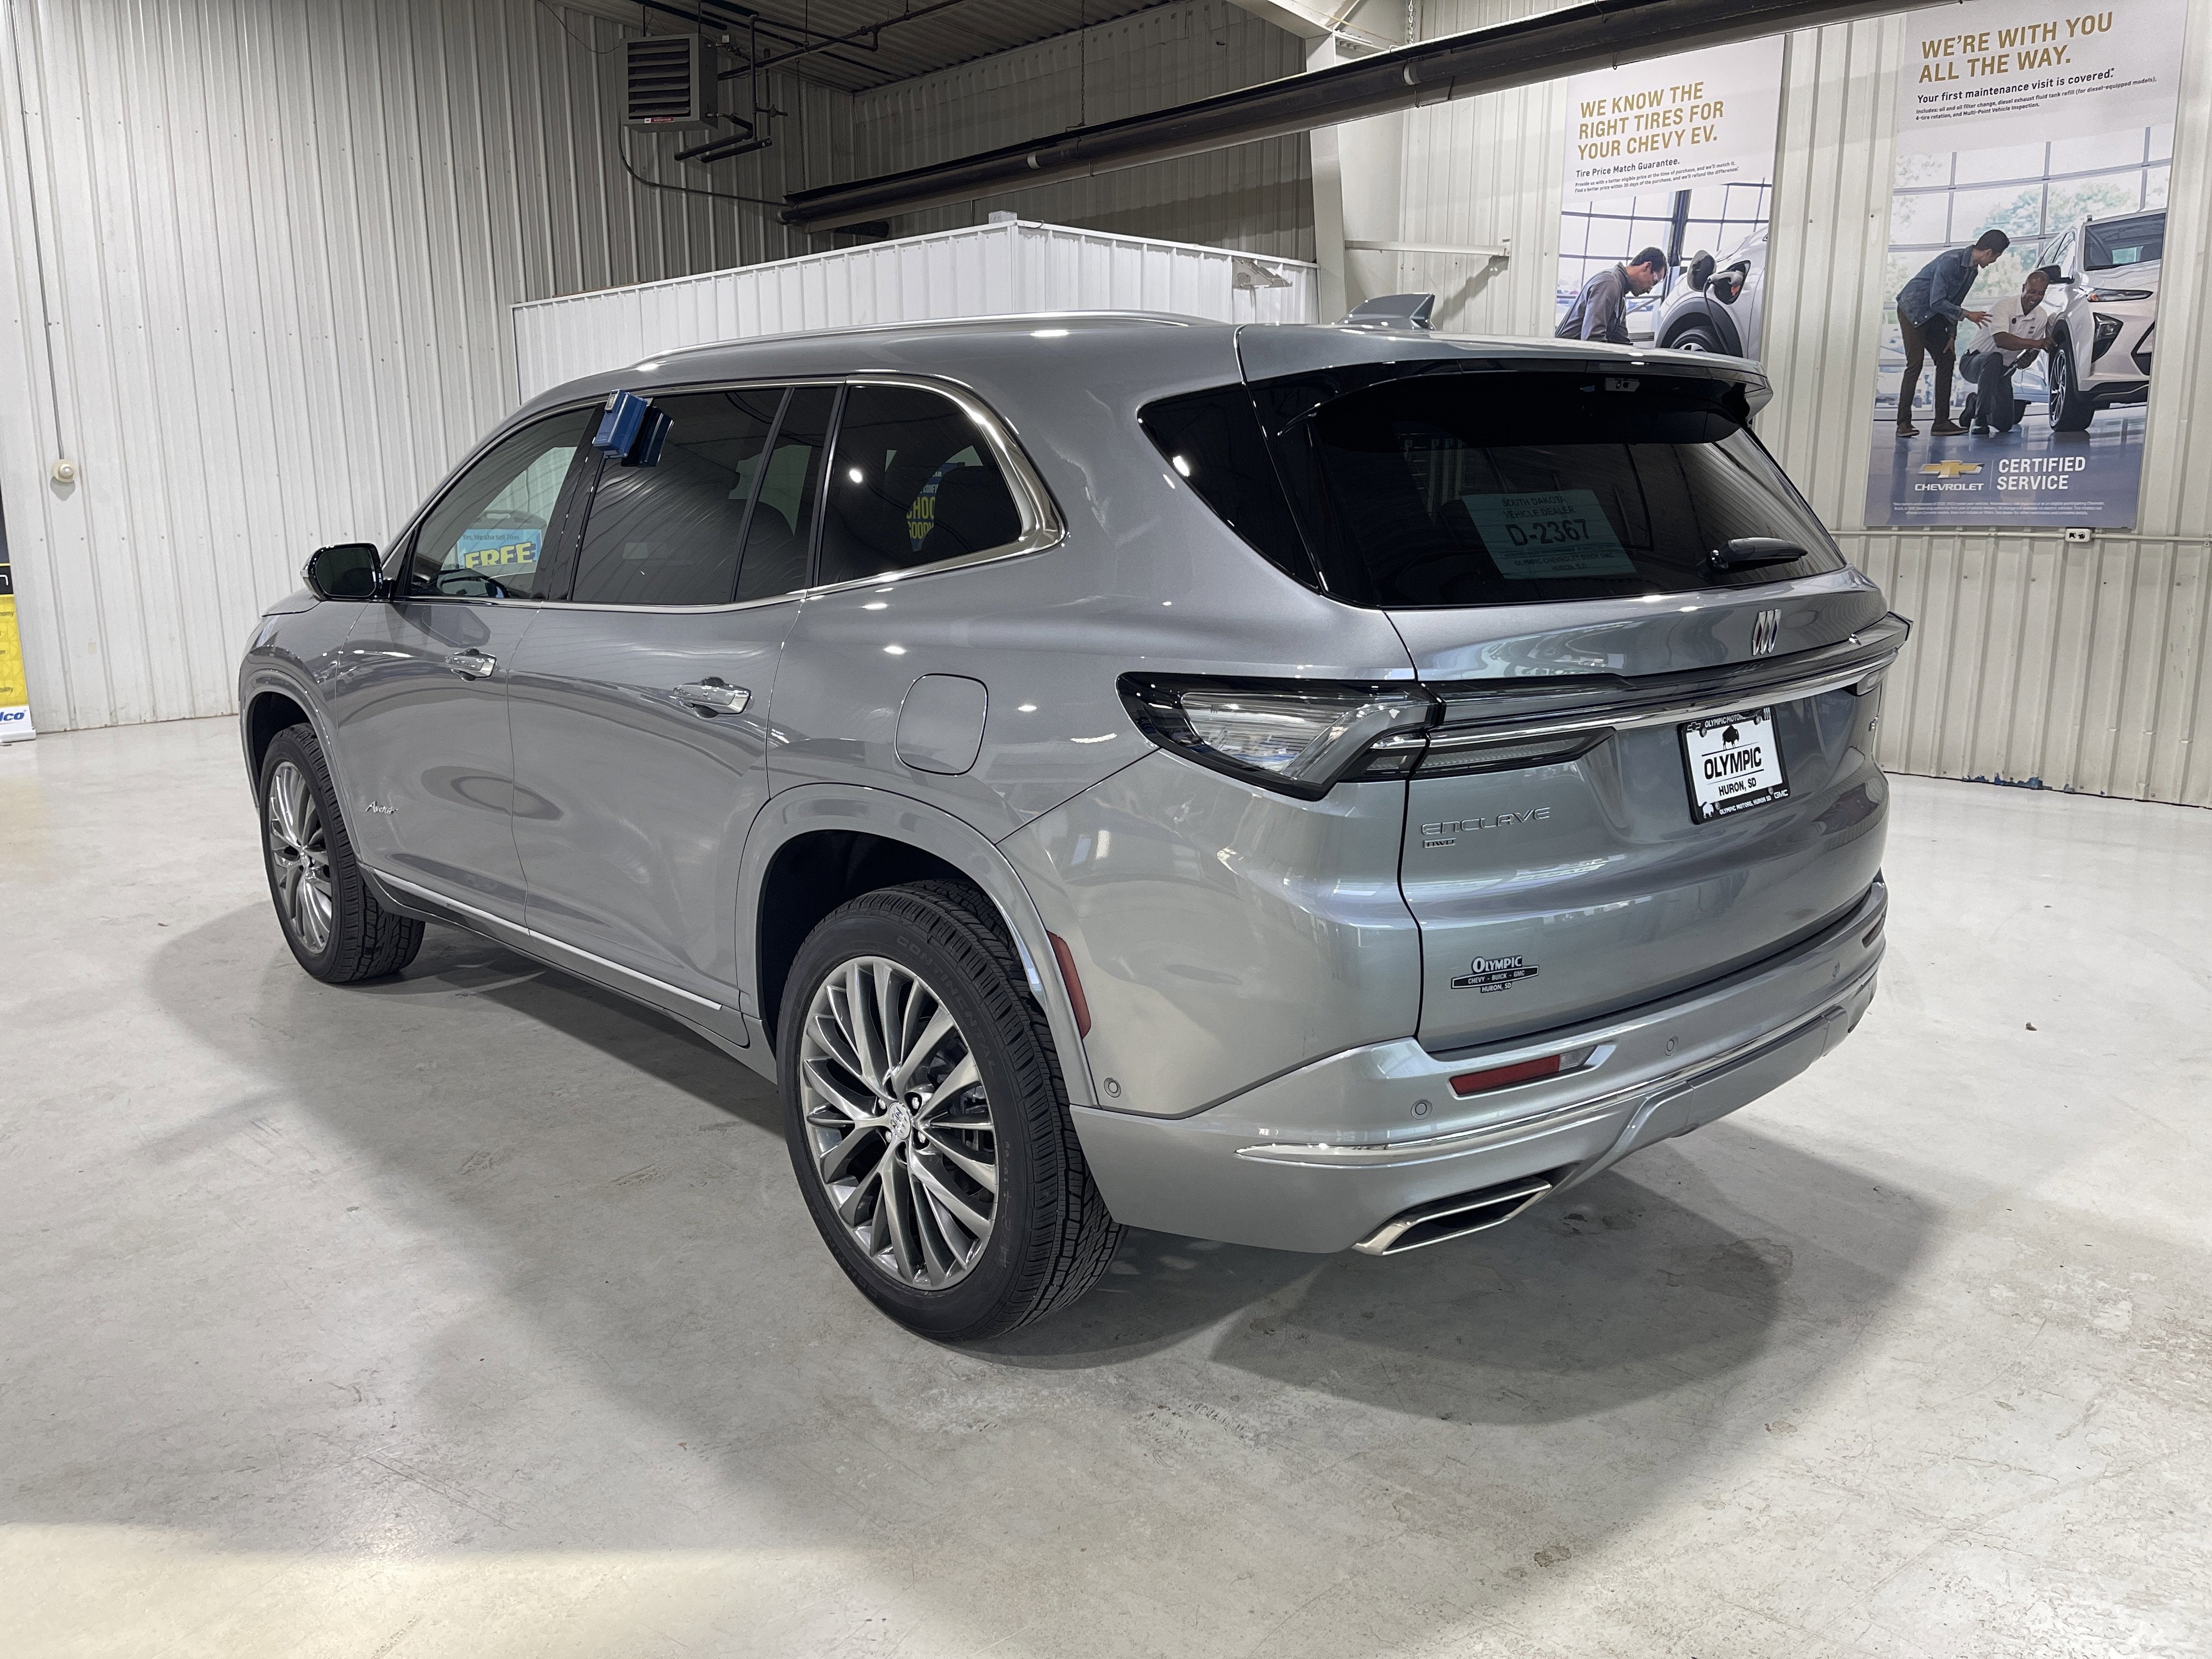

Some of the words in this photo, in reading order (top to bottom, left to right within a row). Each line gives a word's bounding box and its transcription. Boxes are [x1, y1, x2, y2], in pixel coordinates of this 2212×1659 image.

[1998, 21, 2057, 49] WITH
[2065, 11, 2113, 38] YOU
[1918, 63, 1960, 83] ALL
[1967, 54, 2010, 77] THE
[2017, 44, 2071, 71] WAY.
[1917, 94, 1939, 104] Your
[1942, 91, 1963, 101] first
[1965, 84, 2029, 98] maintenance
[2032, 78, 2053, 89] visit
[2056, 77, 2065, 86] is
[2087, 81, 2131, 93] diesel-equipped
[1581, 99, 1606, 119] WE
[1612, 89, 1664, 114] KNOW
[1670, 82, 1704, 104] THE
[1579, 117, 1629, 139] RIGHT
[1634, 108, 1683, 132] TIRES
[1689, 100, 1724, 122] FOR
[1577, 140, 1620, 160] YOUR
[1627, 128, 1686, 154] CHEVY
[1691, 125, 1718, 144] EV.
[1576, 170, 1590, 178] Tire
[1592, 167, 1611, 176] Price
[1613, 163, 1635, 174] Match
[1638, 159, 1680, 170] Guarantee.
[1998, 456, 2085, 473] CERTIFIED
[1914, 483, 1984, 491] CHEVROLET
[1996, 475, 2069, 490] SERVICE
[1502, 498, 1530, 507] SOUTH
[1533, 496, 1566, 505] DAKOTA
[1503, 509, 1539, 519] VEHICLE
[1542, 506, 1575, 516] DEALER
[1505, 518, 1590, 546] D-2367
[1704, 718, 1726, 728] OLYMPIC
[1705, 746, 1762, 780] OLYMPIC
[1718, 780, 1747, 796] HURON,
[1748, 777, 1757, 787] SD
[1774, 789, 1788, 799] GMC
[1719, 805, 1736, 815] OLYMPIC
[1421, 807, 1550, 835] ENCLAVE
[1427, 839, 1454, 848] AWD
[1468, 976, 1485, 984] CHEVY
[1492, 973, 1507, 981] BUICK
[1482, 984, 1503, 992] HURON,
